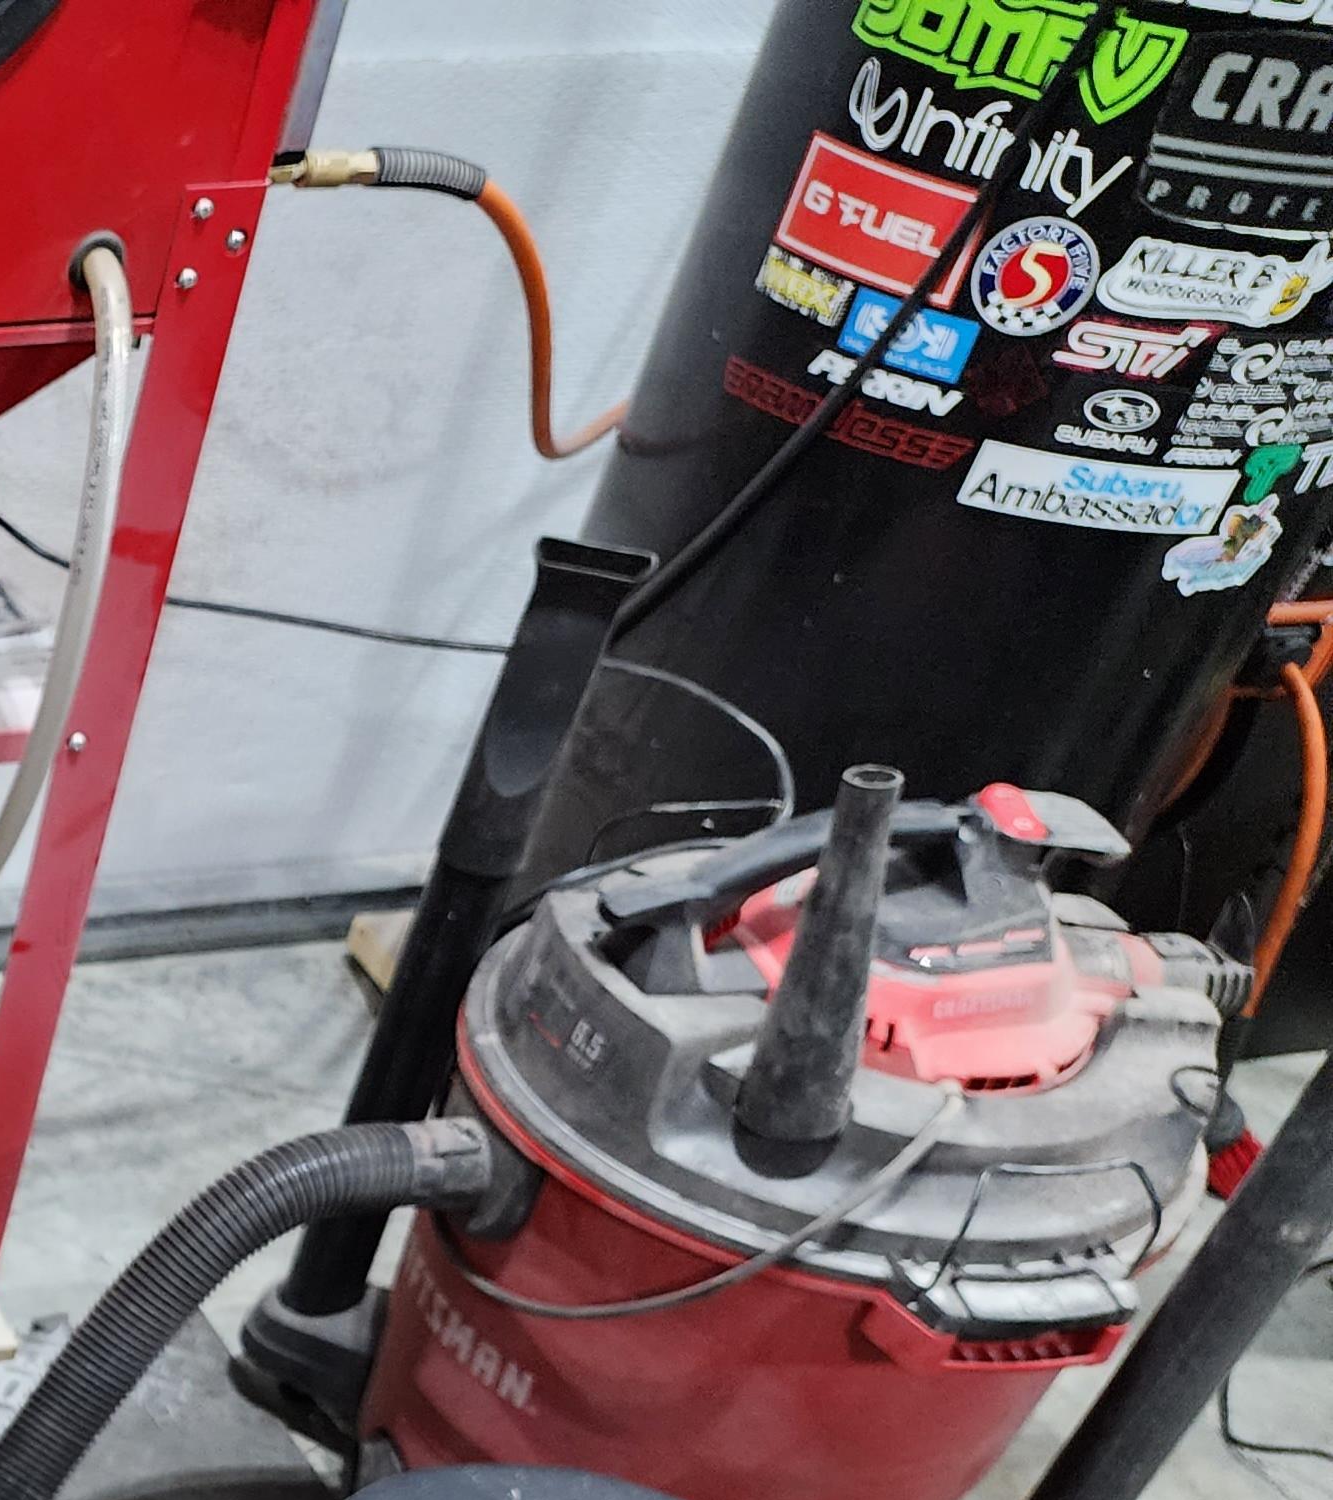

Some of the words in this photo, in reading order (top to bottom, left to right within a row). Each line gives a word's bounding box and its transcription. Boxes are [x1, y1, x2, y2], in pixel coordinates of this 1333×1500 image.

[901, 87, 1134, 218] Infinity
[981, 224, 1077, 275] FACTORY
[1066, 242, 1092, 291] FIVE
[1053, 424, 1158, 455] SUBARU
[968, 472, 1214, 527] Ambassador
[1063, 464, 1181, 499] Subaru
